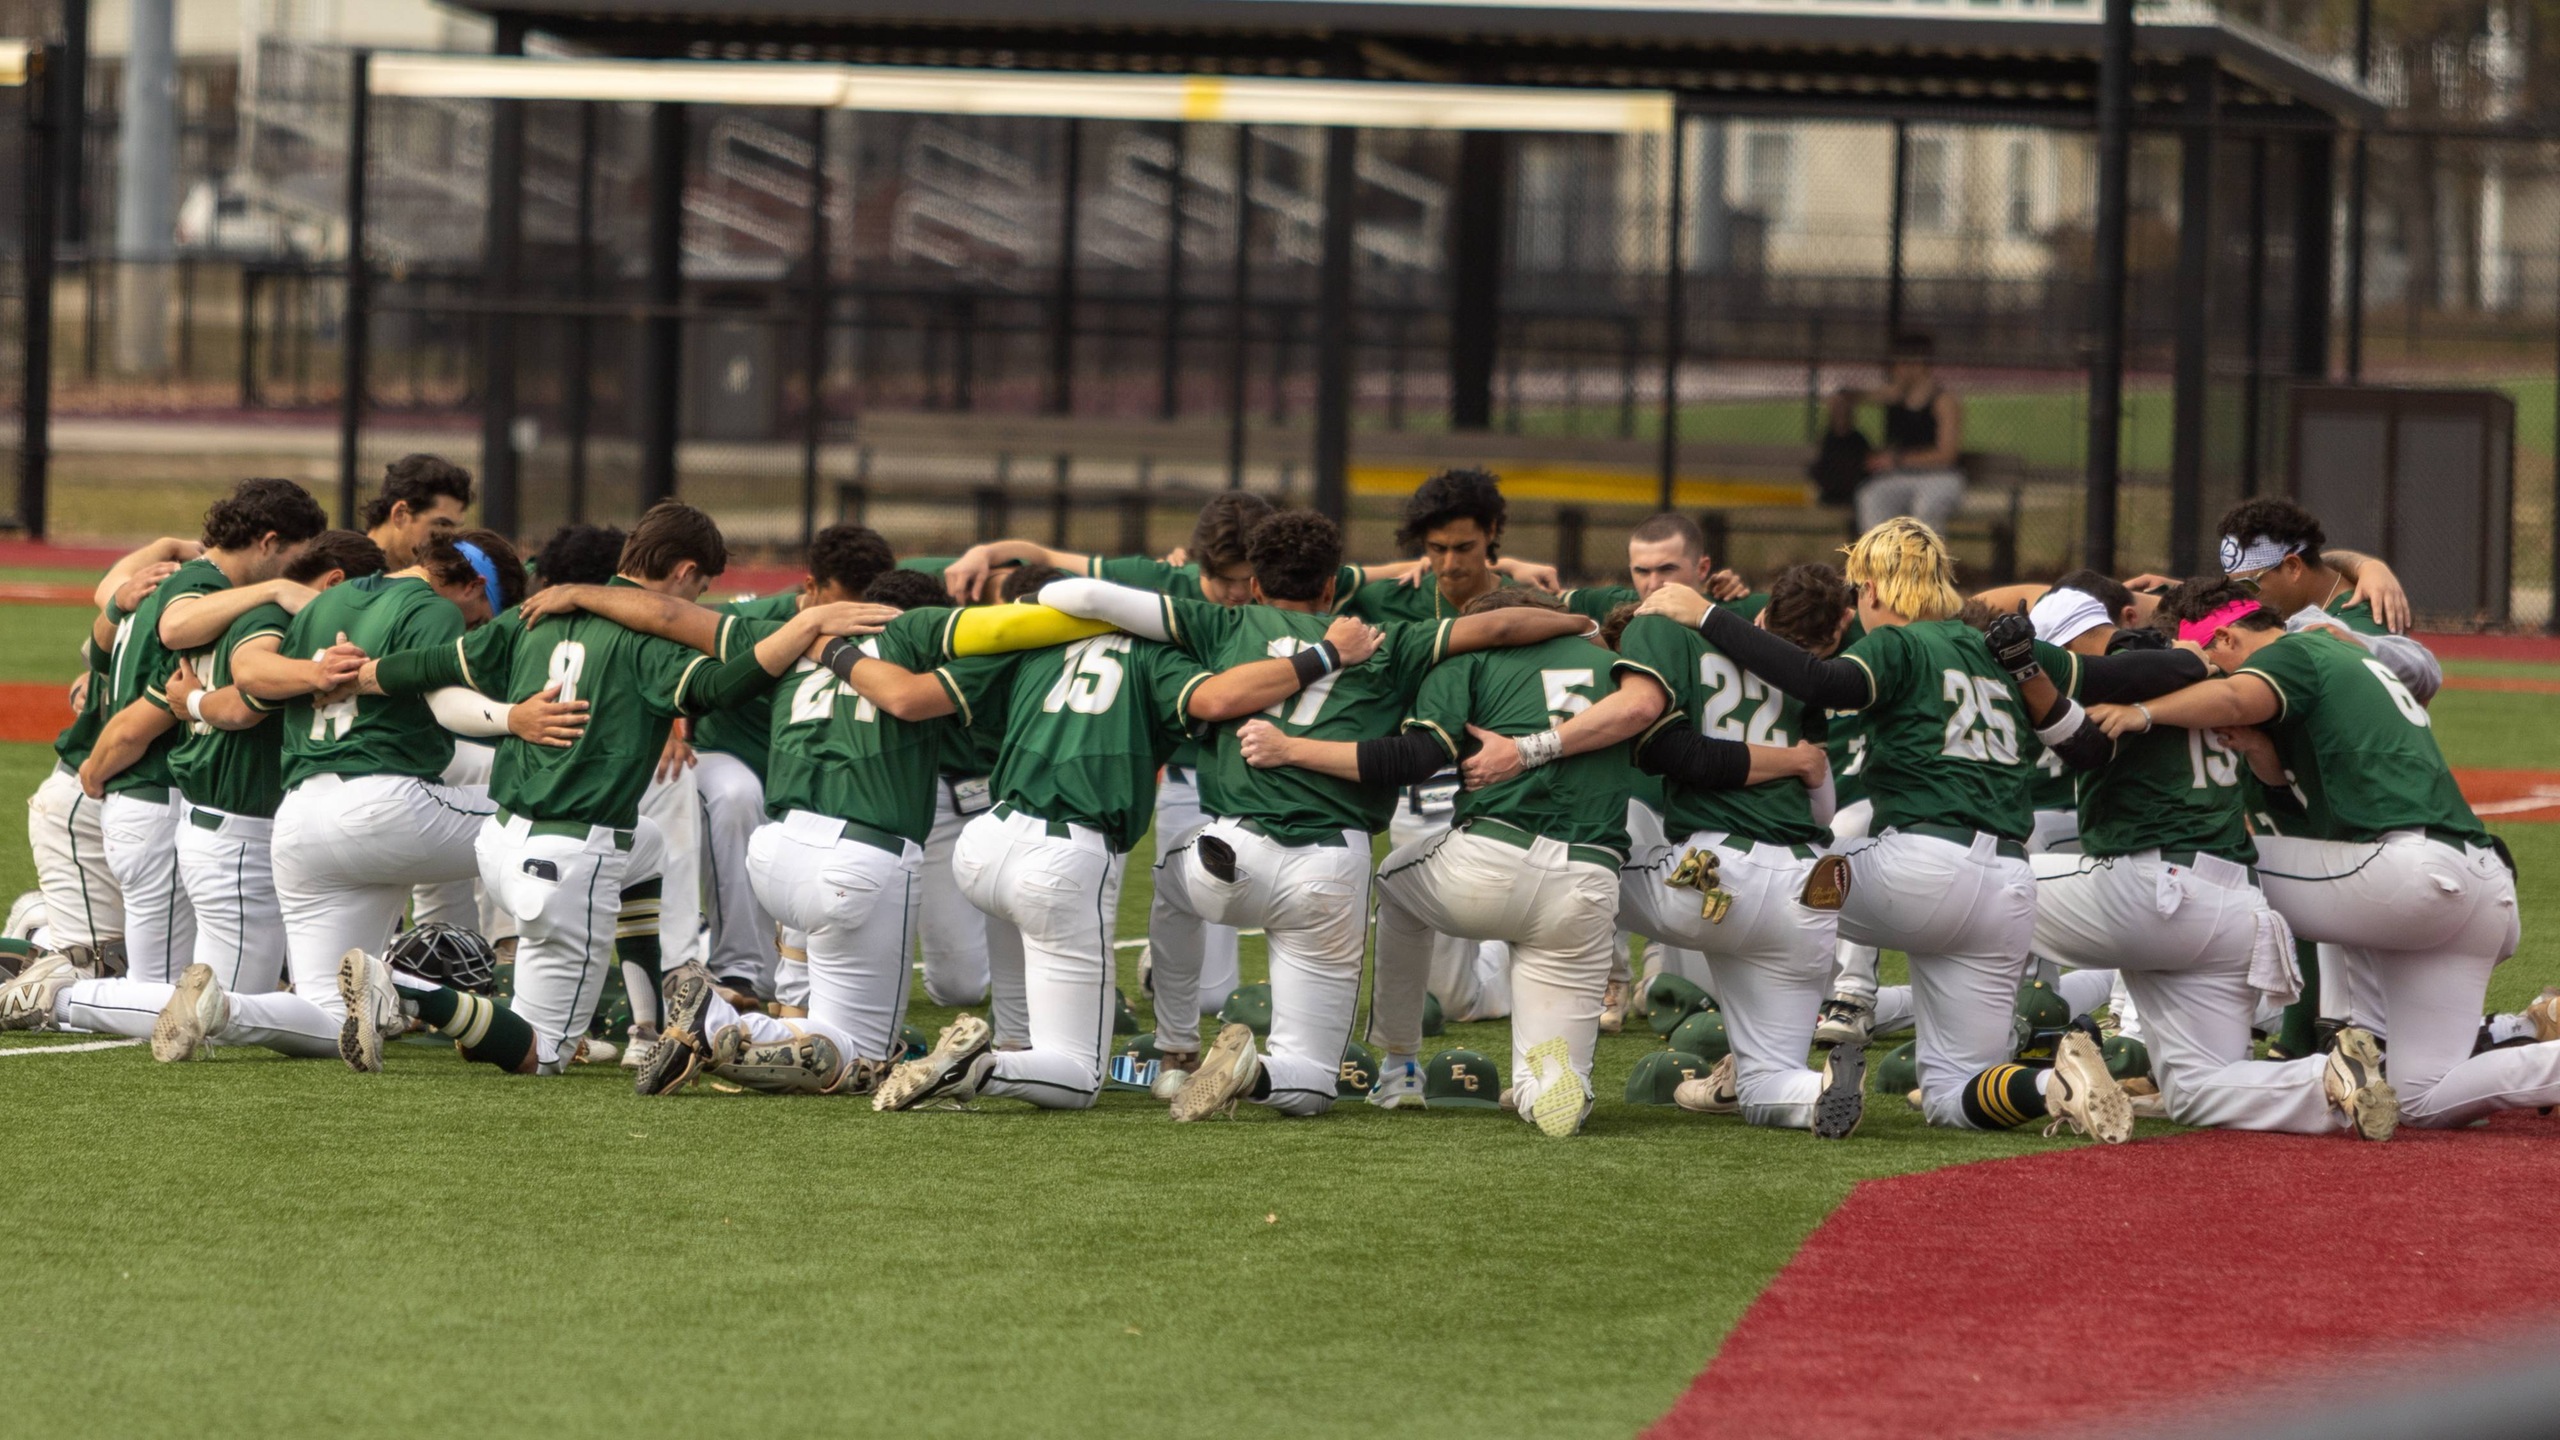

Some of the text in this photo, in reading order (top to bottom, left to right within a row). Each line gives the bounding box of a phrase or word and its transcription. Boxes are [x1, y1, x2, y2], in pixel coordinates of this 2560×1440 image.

[789, 637, 880, 724] 24
[1043, 633, 1132, 715] 15
[1267, 636, 1344, 726] 17
[1541, 669, 1594, 731] 5
[1700, 653, 1788, 748] 22
[1941, 669, 2020, 766] 25
[1340, 1061, 1368, 1089] EC
[1451, 1064, 1479, 1092] EC
